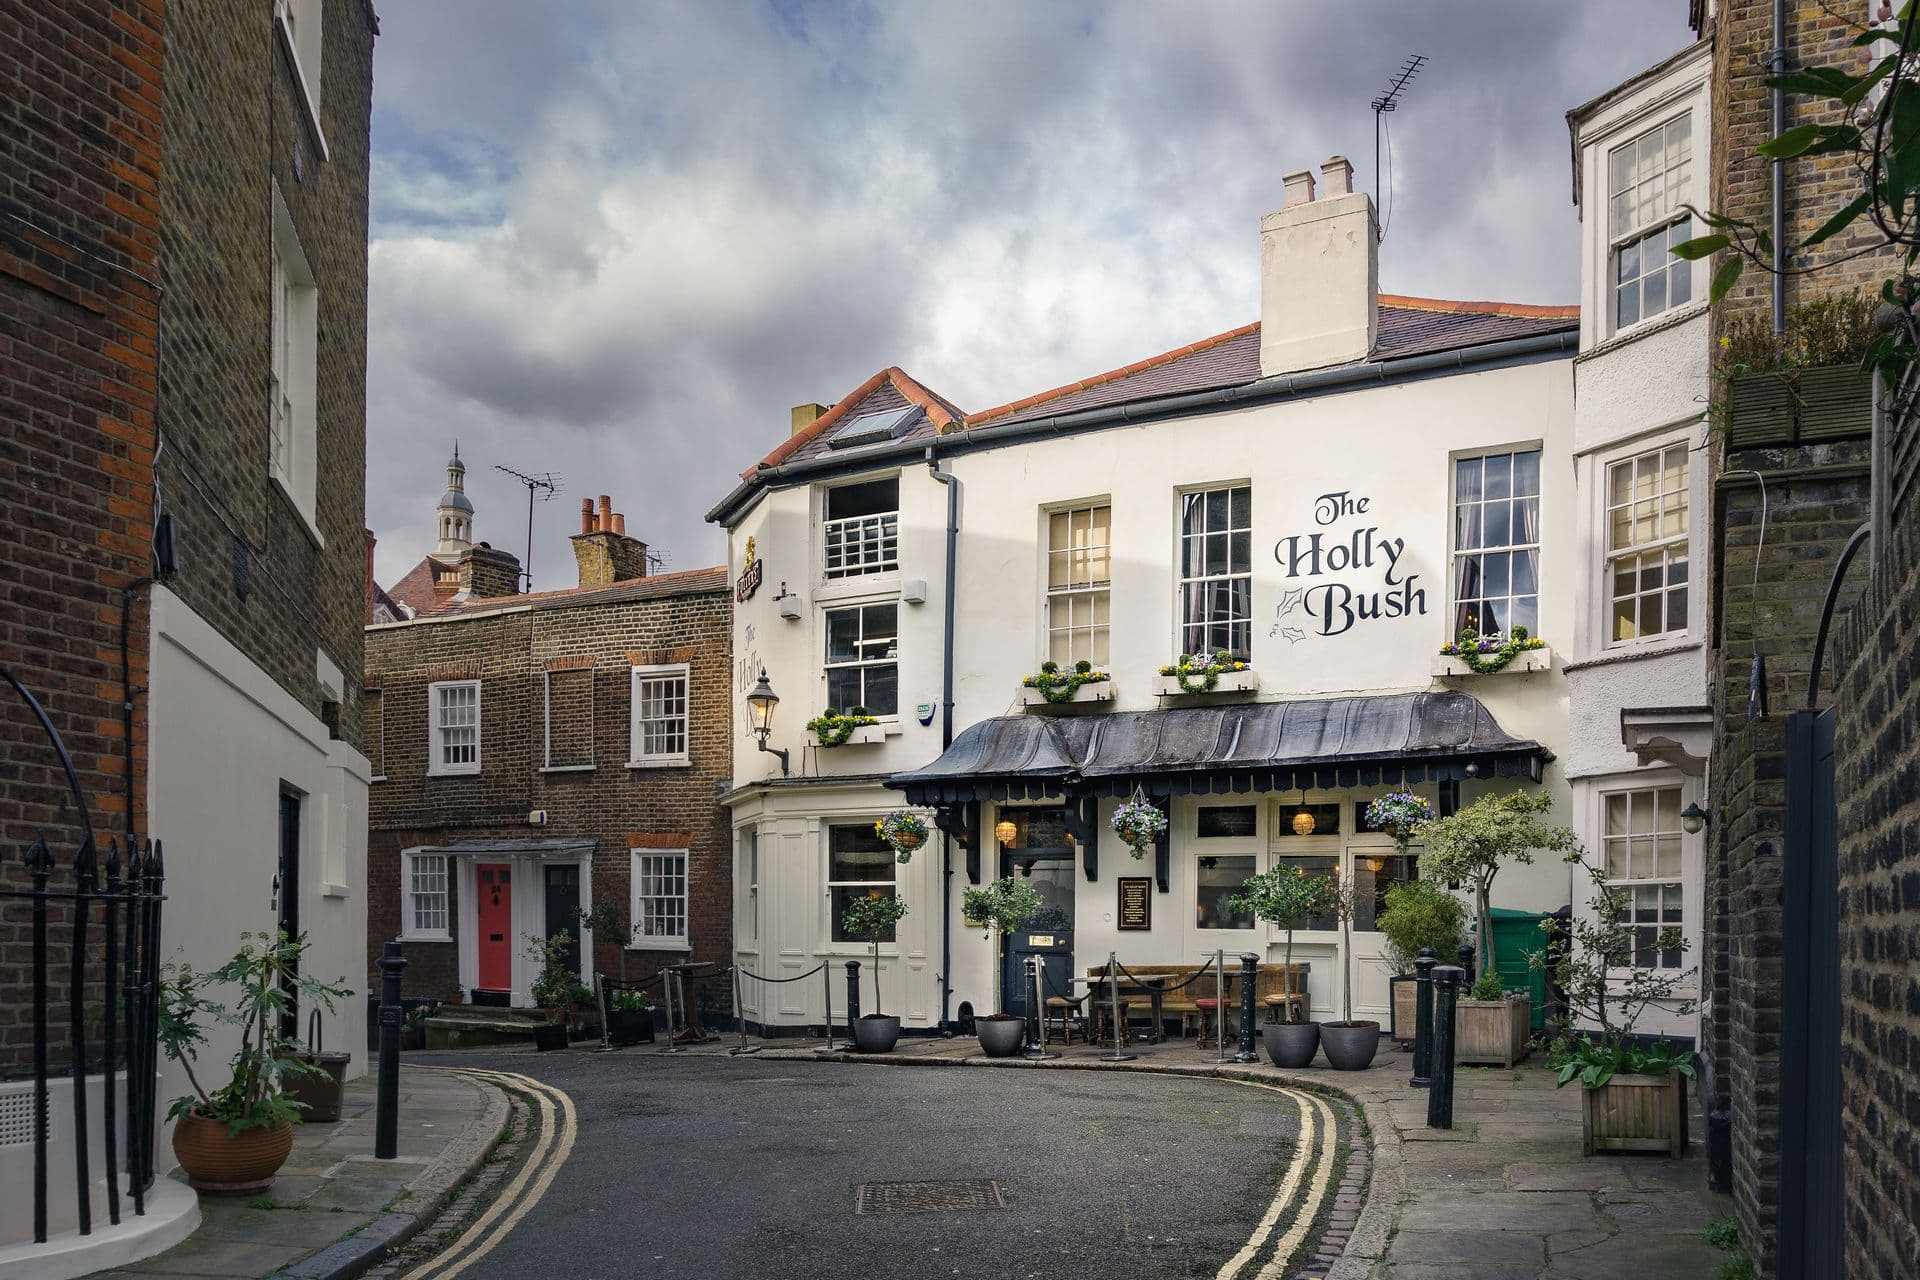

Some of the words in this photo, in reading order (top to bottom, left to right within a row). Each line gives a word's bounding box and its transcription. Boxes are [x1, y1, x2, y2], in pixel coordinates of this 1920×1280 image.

[1314, 490, 1370, 526] The
[1274, 526, 1405, 586] Holly
[1303, 574, 1428, 637] Bush
